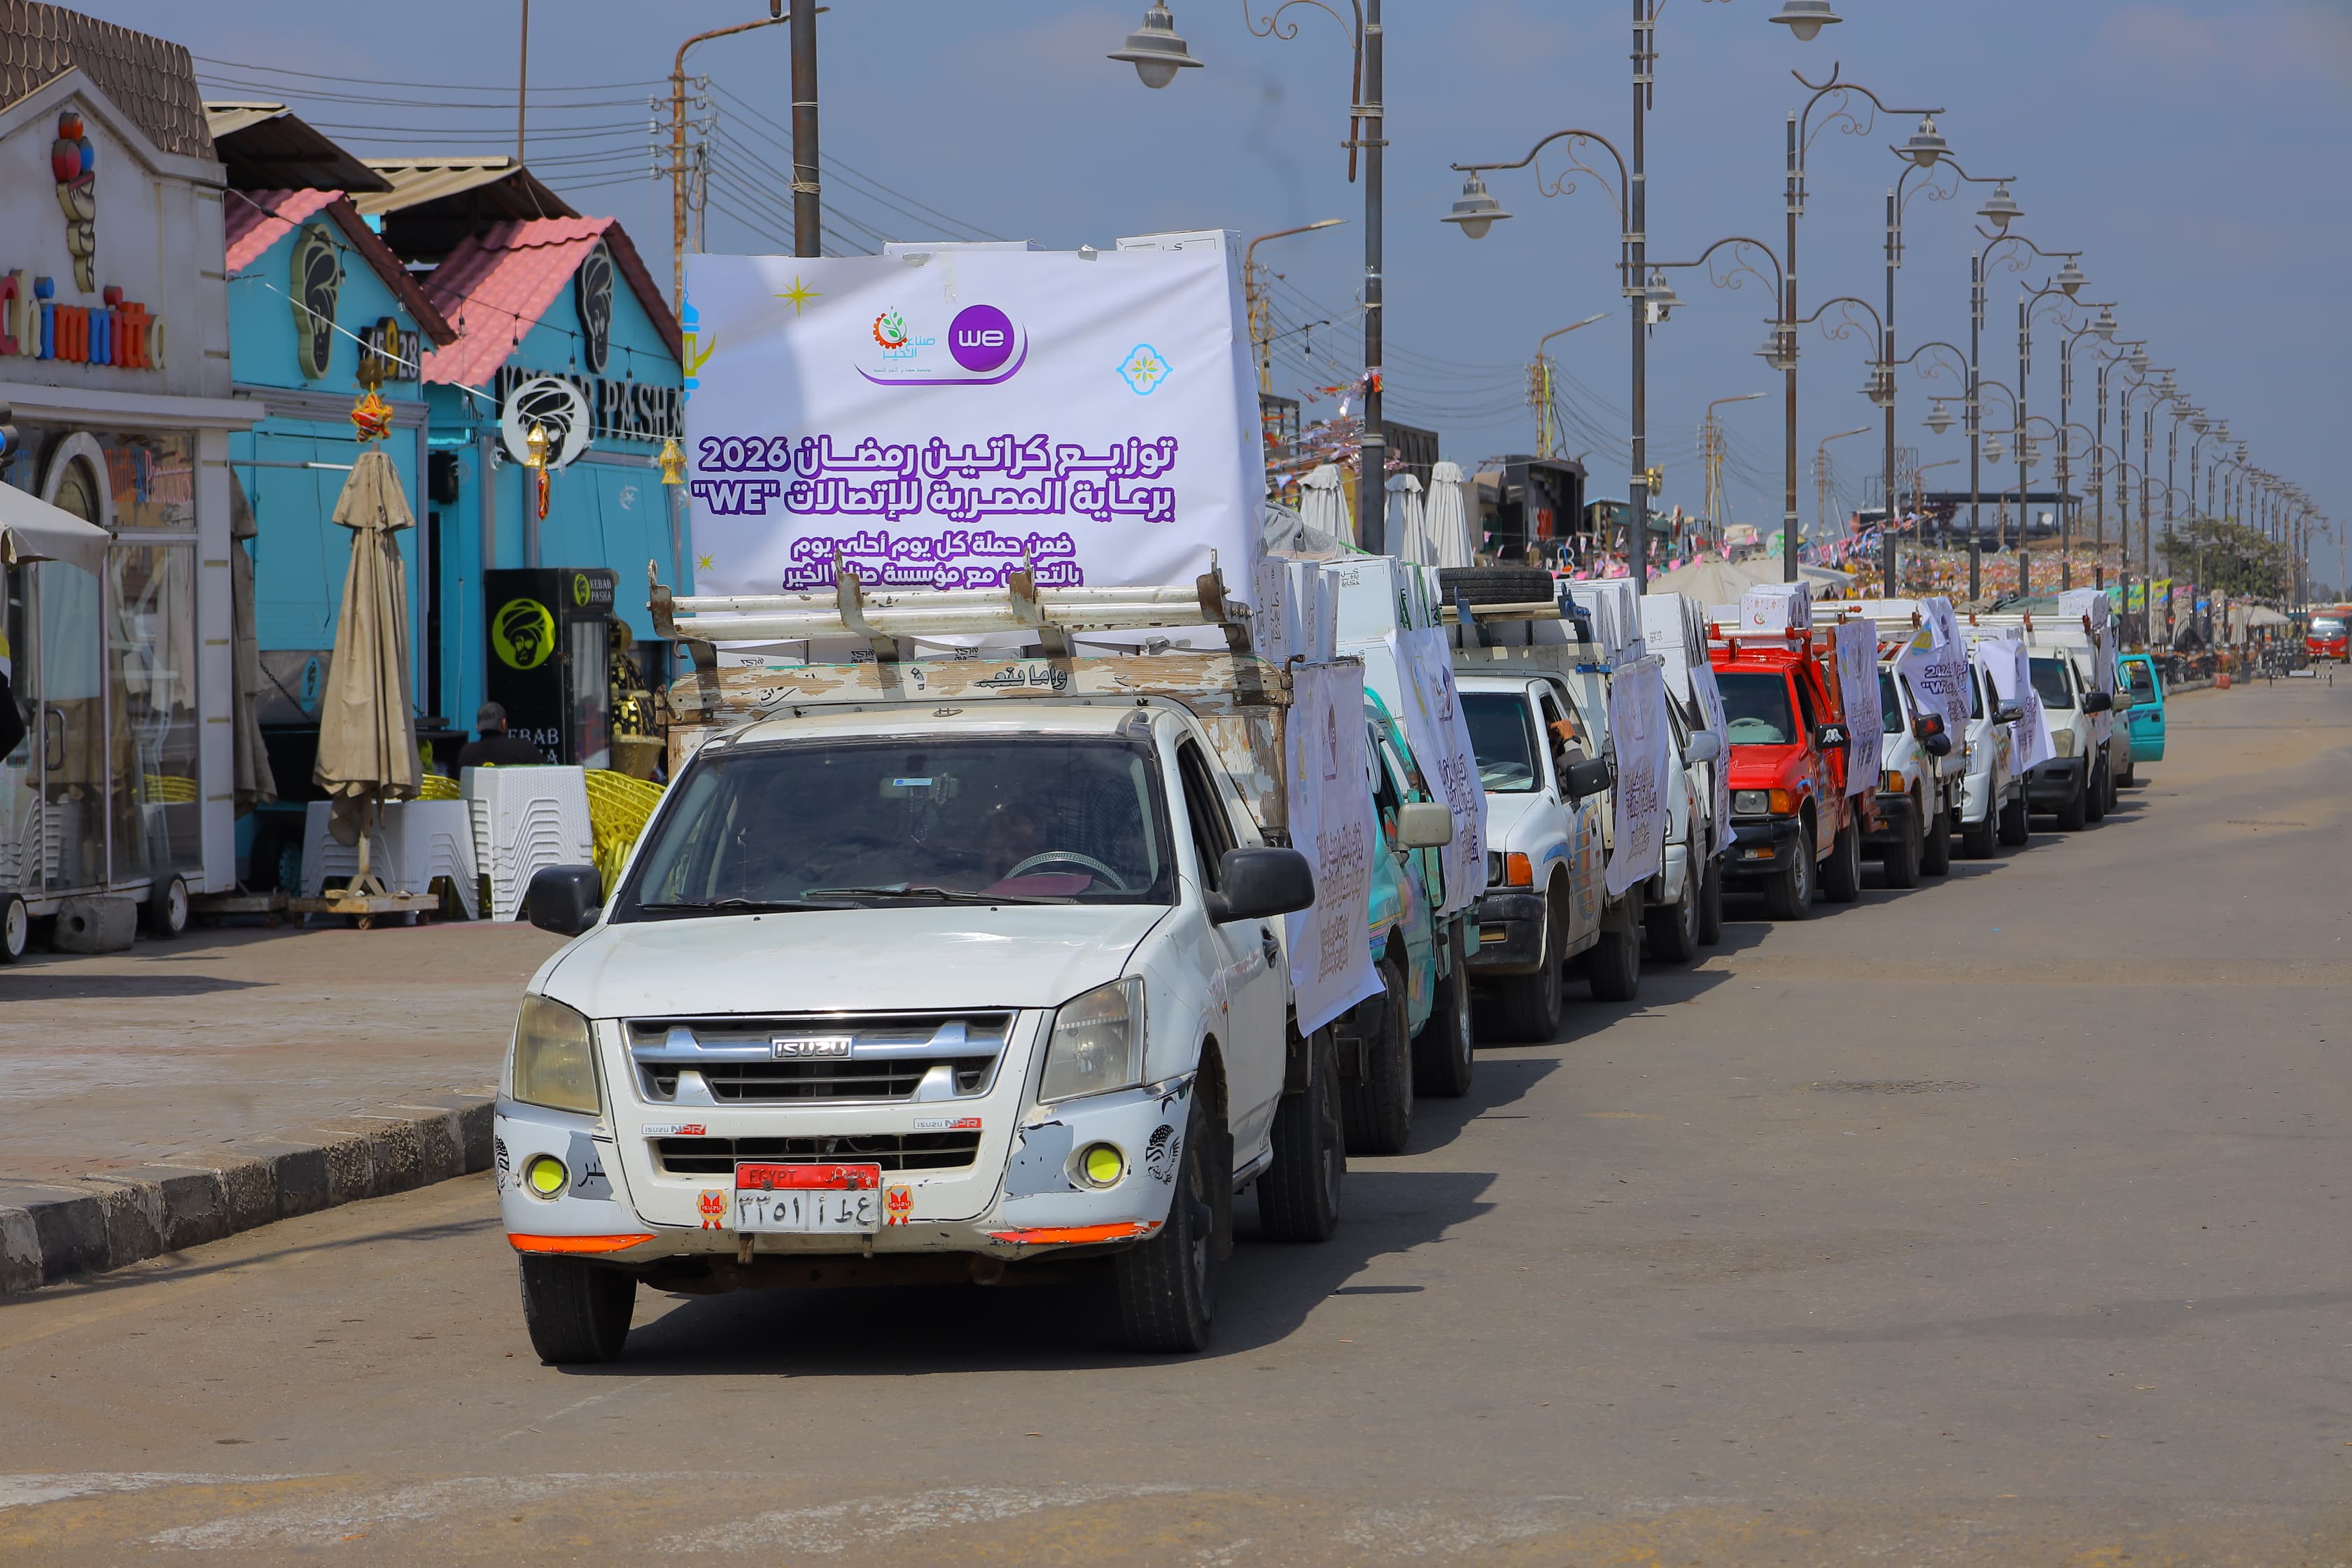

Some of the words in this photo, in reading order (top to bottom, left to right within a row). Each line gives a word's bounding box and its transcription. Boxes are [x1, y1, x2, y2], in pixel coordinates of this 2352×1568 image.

[907, 336, 936, 349] صناع
[958, 330, 1004, 347] we
[883, 347, 917, 361] الخير
[699, 437, 791, 472] 2026
[794, 435, 918, 479] رمضان
[923, 435, 1051, 479] كراتين
[1056, 437, 1177, 479] توزيع
[692, 479, 780, 514] "WE"
[784, 478, 922, 522] للإتصالات
[927, 478, 1065, 522] المصرية
[1071, 479, 1175, 522] برعاية
[792, 537, 834, 561] يوم
[890, 537, 932, 561] يوم
[933, 531, 969, 561] كل
[970, 531, 1023, 556] حملة
[1025, 532, 1076, 559] ضمن
[590, 578, 611, 589] KEBAB
[783, 561, 834, 590] الخير
[883, 562, 962, 589] مؤسسة
[963, 565, 997, 589] مع
[592, 592, 612, 602] PASHA
[507, 728, 559, 745] EBAB
[776, 1042, 848, 1056] ISUZU
[671, 1124, 706, 1135] NPR
[944, 1119, 980, 1129] NPR
[750, 1169, 797, 1184] EGYPT
